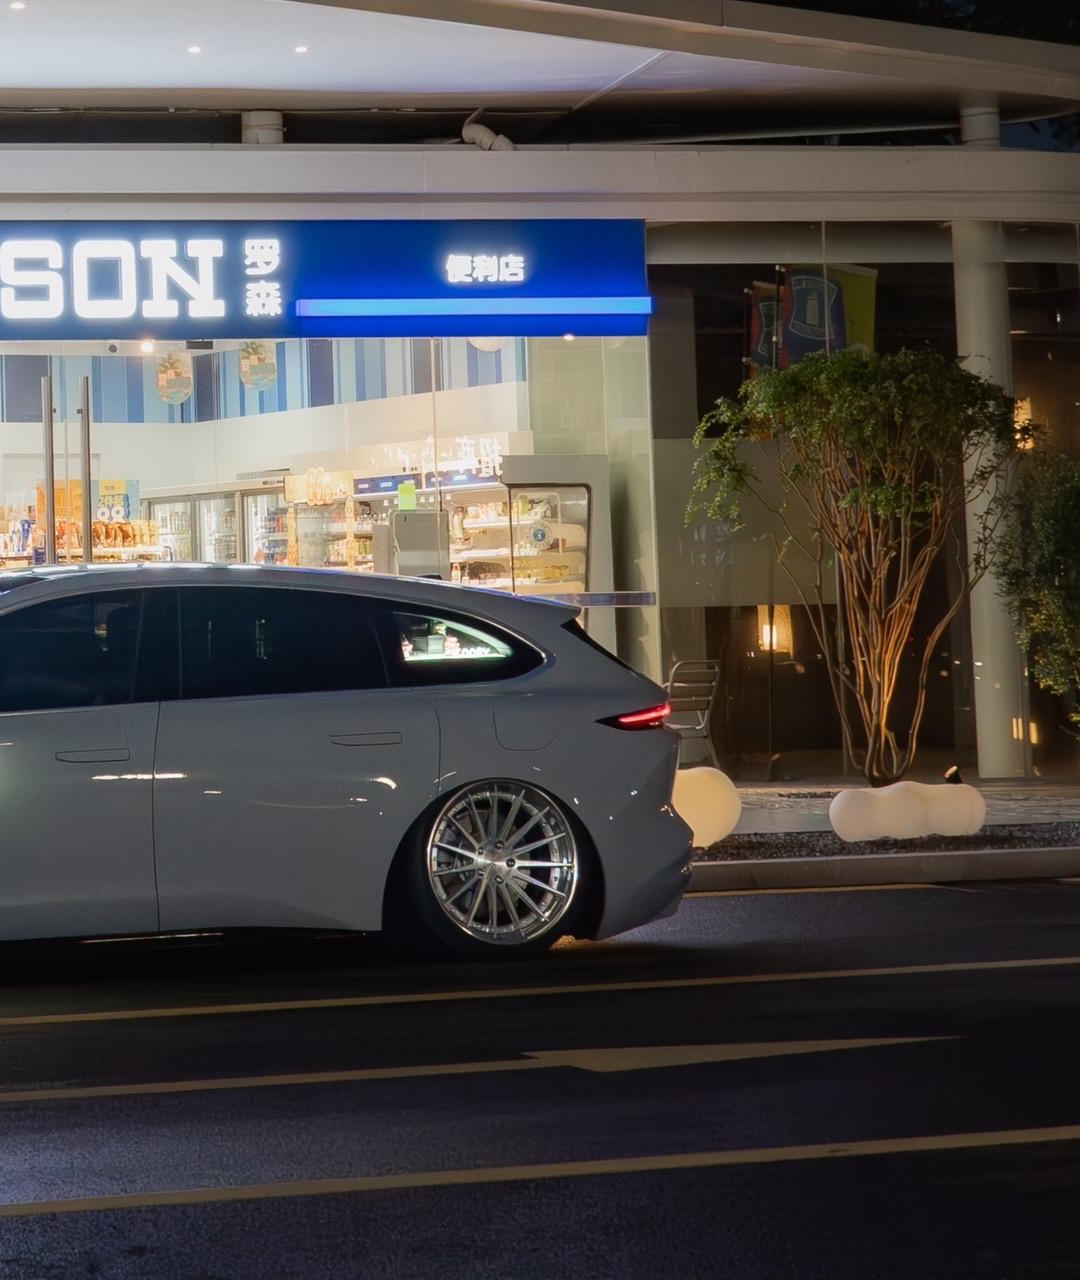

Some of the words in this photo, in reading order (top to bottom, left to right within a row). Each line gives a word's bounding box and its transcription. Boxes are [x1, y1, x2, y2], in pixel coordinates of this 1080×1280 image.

[245, 239, 282, 317] 罗森
[446, 254, 524, 282] 便利店
